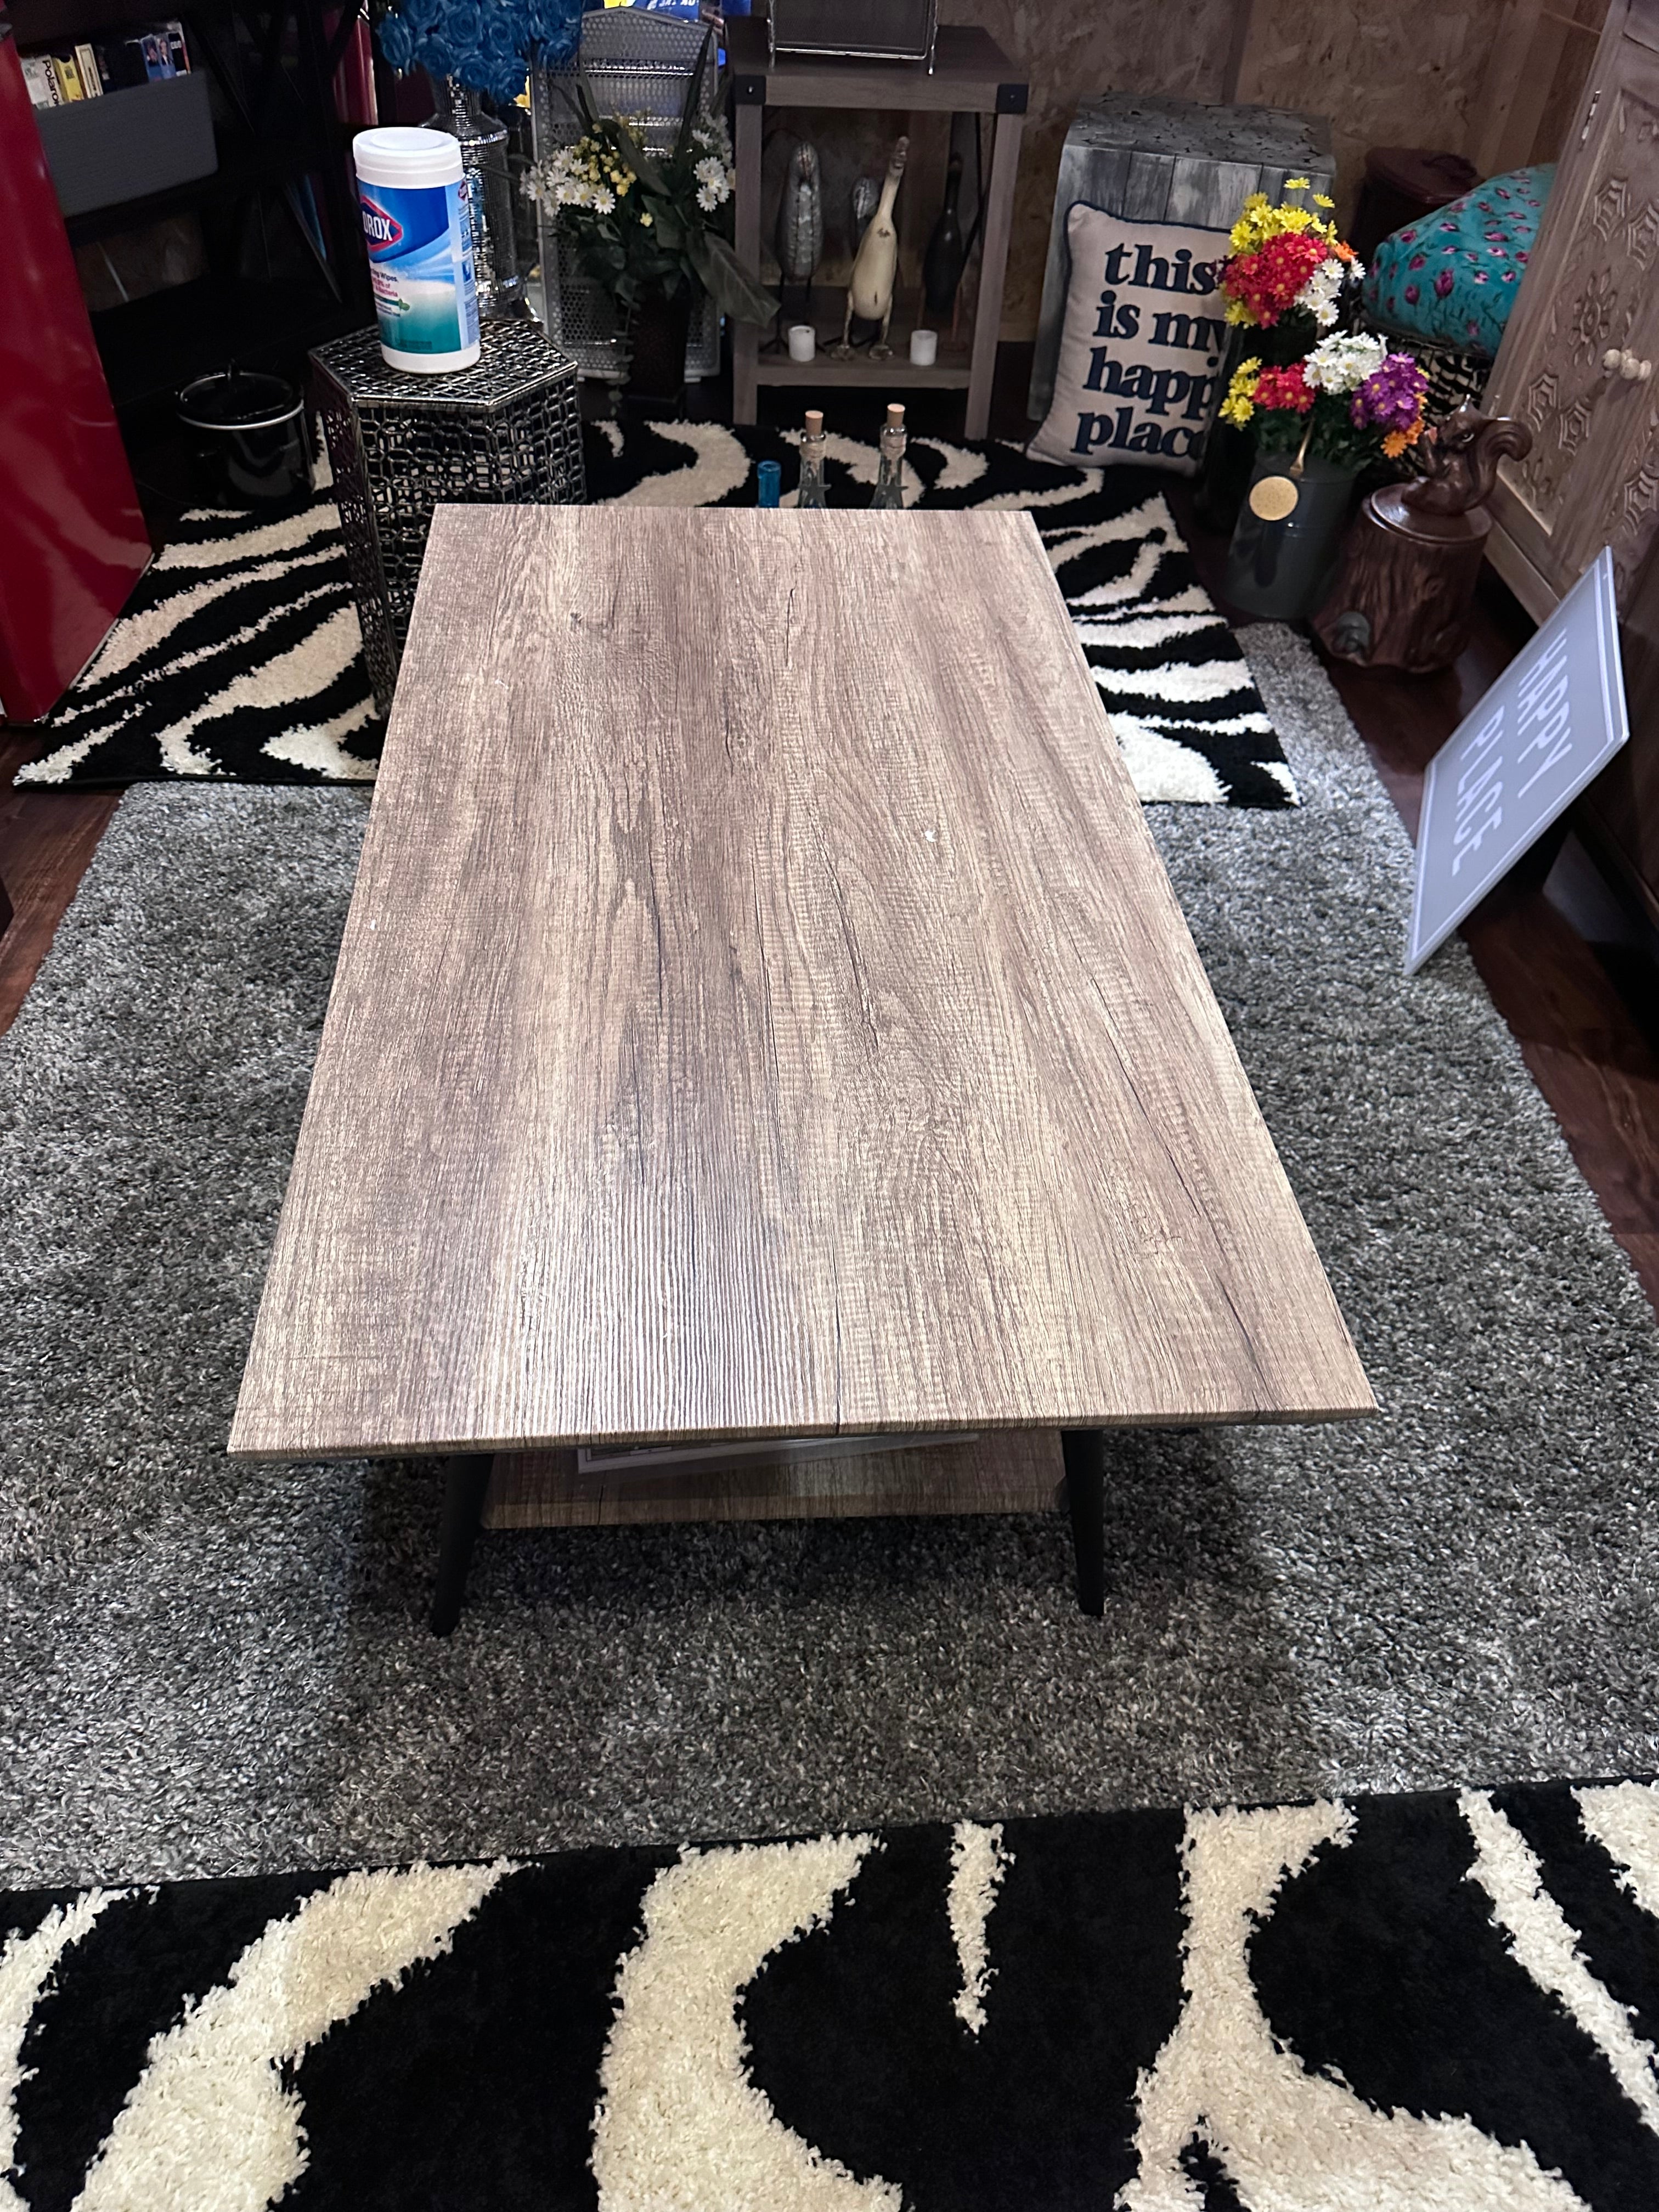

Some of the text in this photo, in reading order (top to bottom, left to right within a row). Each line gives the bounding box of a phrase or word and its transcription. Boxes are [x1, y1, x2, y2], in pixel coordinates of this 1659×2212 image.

[42, 60, 60, 105] Polaro
[362, 211, 393, 241] OROX
[1105, 243, 1216, 295] this
[1093, 290, 1140, 339] is
[1082, 347, 1217, 421] happ
[1517, 628, 1572, 799] HAPPY
[1452, 706, 1504, 877] PLACE
